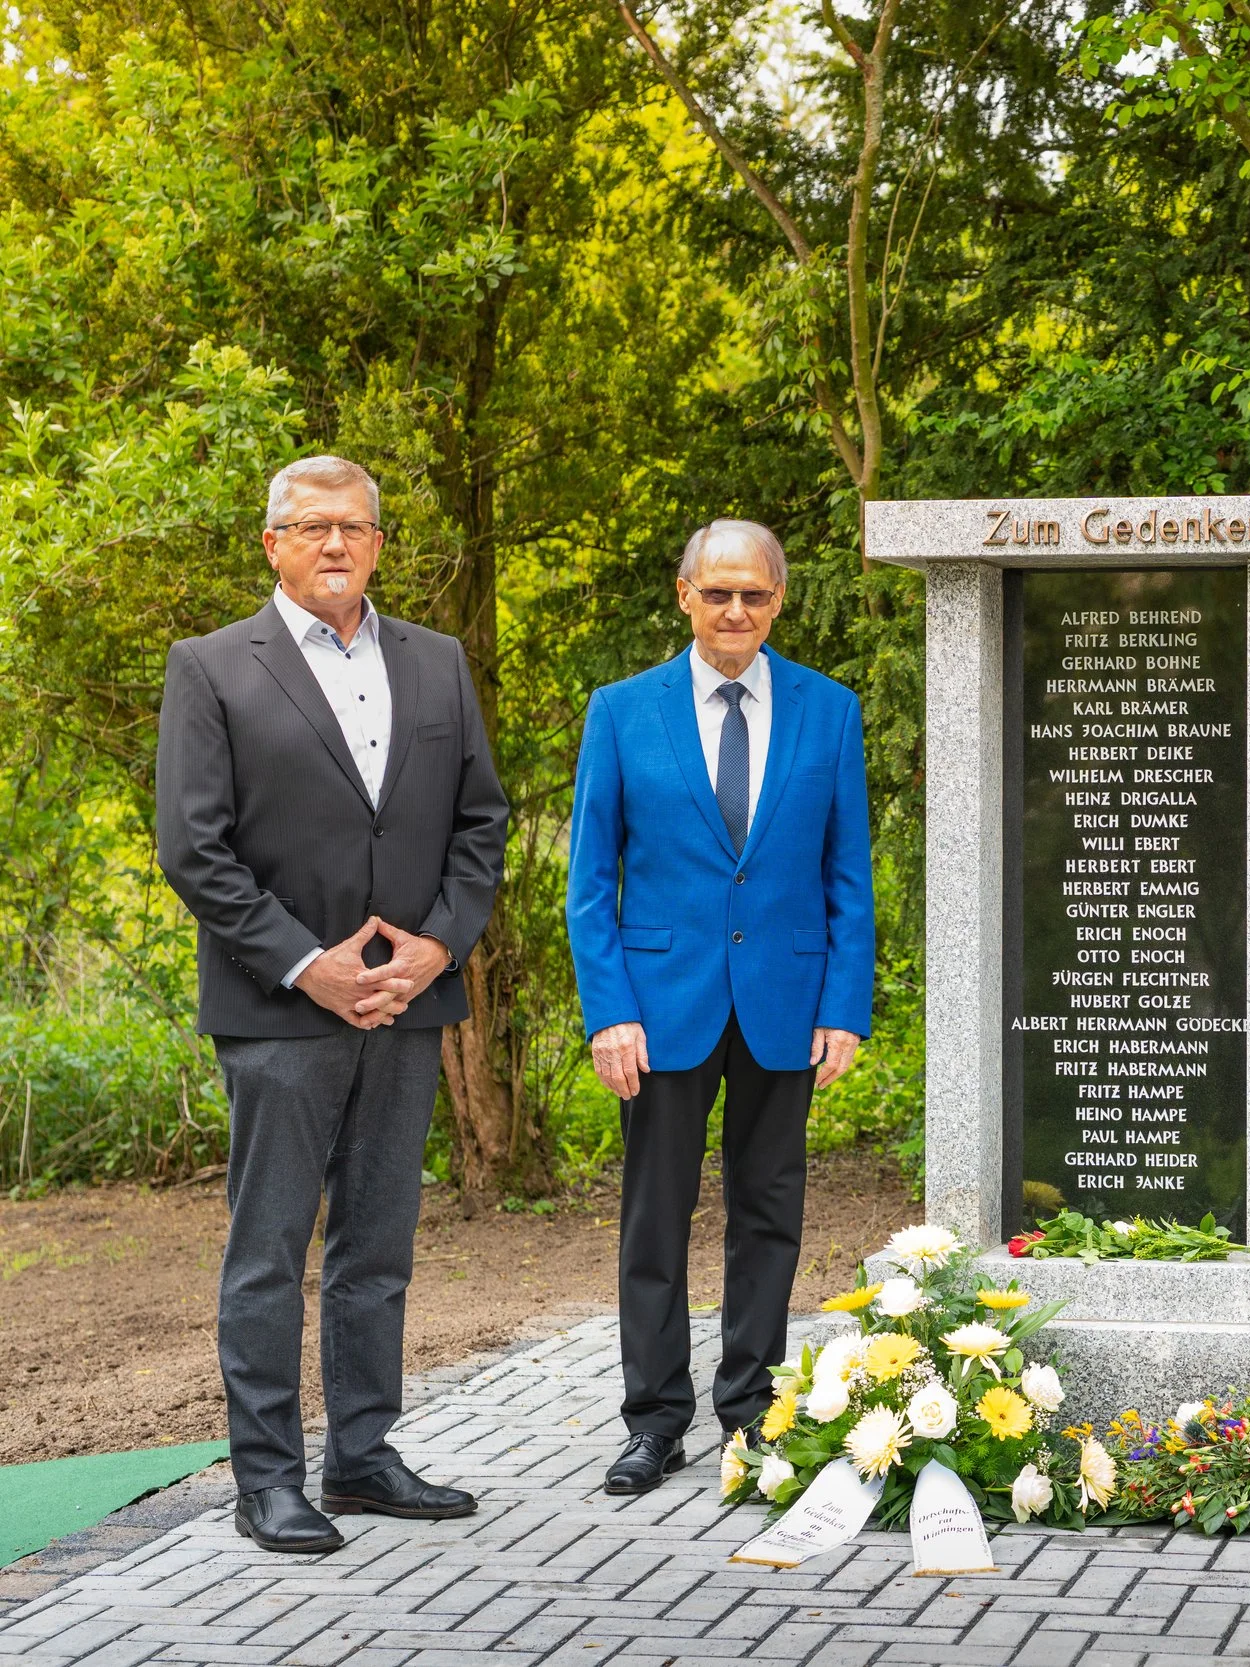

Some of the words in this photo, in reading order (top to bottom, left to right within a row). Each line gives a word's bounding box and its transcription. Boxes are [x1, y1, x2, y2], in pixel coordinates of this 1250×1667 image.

[982, 509, 1060, 545] Zum
[1060, 611, 1120, 626] ALFRED
[1129, 610, 1202, 625] BEHREND
[1065, 633, 1109, 648] FRITZ
[1118, 632, 1198, 648] BERKLING
[1061, 655, 1137, 671] GERHARD
[1145, 655, 1201, 670] BOHNE
[1046, 678, 1137, 694] HERRMANN
[1146, 677, 1217, 693] BRÄMER
[1072, 701, 1114, 716] KARL
[1120, 700, 1190, 716] BRÄMER
[1030, 723, 1073, 739] HANS
[1081, 723, 1159, 738] JOACHIM
[1167, 723, 1232, 738] BRAUNE
[1068, 746, 1139, 761] HERBERT
[1146, 745, 1194, 761] DEIKE
[1048, 768, 1125, 784] WILHELM
[1133, 768, 1215, 784] DRESCHER
[1065, 791, 1111, 806] HEINZ
[1120, 791, 1198, 806] DRIGALLA
[1073, 813, 1120, 829] ERICH
[1130, 813, 1189, 829] DUMKE
[1081, 836, 1125, 852] WILLI
[1134, 836, 1181, 852] EBERT
[1065, 857, 1142, 874] HERBERT
[1150, 858, 1197, 874] EBERT
[1062, 881, 1131, 897] HERBERT
[1140, 881, 1200, 896] EMMIG
[1065, 901, 1130, 919] GÜNTER
[1136, 903, 1197, 919] ENGLER
[1076, 926, 1122, 941] ERICH
[1132, 926, 1187, 942] ENOCH
[1076, 949, 1121, 964] OTTO
[1130, 949, 1185, 964] ENOCH
[1051, 969, 1114, 987] JÜRGEN
[1122, 971, 1211, 987] FLECHTNER
[1070, 994, 1132, 1009] HUBERT
[1137, 994, 1192, 1010] GOLZE
[1053, 1038, 1100, 1054] ERICH
[1108, 1039, 1209, 1055] HABERMANN
[1055, 1061, 1099, 1077] FRITZ
[1107, 1061, 1207, 1078] HABERMANN
[1078, 1084, 1121, 1099] FRITZ
[1127, 1084, 1185, 1100] HAMPE
[1075, 1106, 1123, 1122] HEINO
[1131, 1107, 1188, 1123] HAMPE
[1082, 1129, 1119, 1144] PAUL
[1125, 1129, 1181, 1145] HAMPE
[1064, 1151, 1138, 1167] GERHARD
[1144, 1152, 1199, 1168] HEIDER
[1077, 1173, 1125, 1189] ERICH
[1135, 1175, 1185, 1191] JANKE
